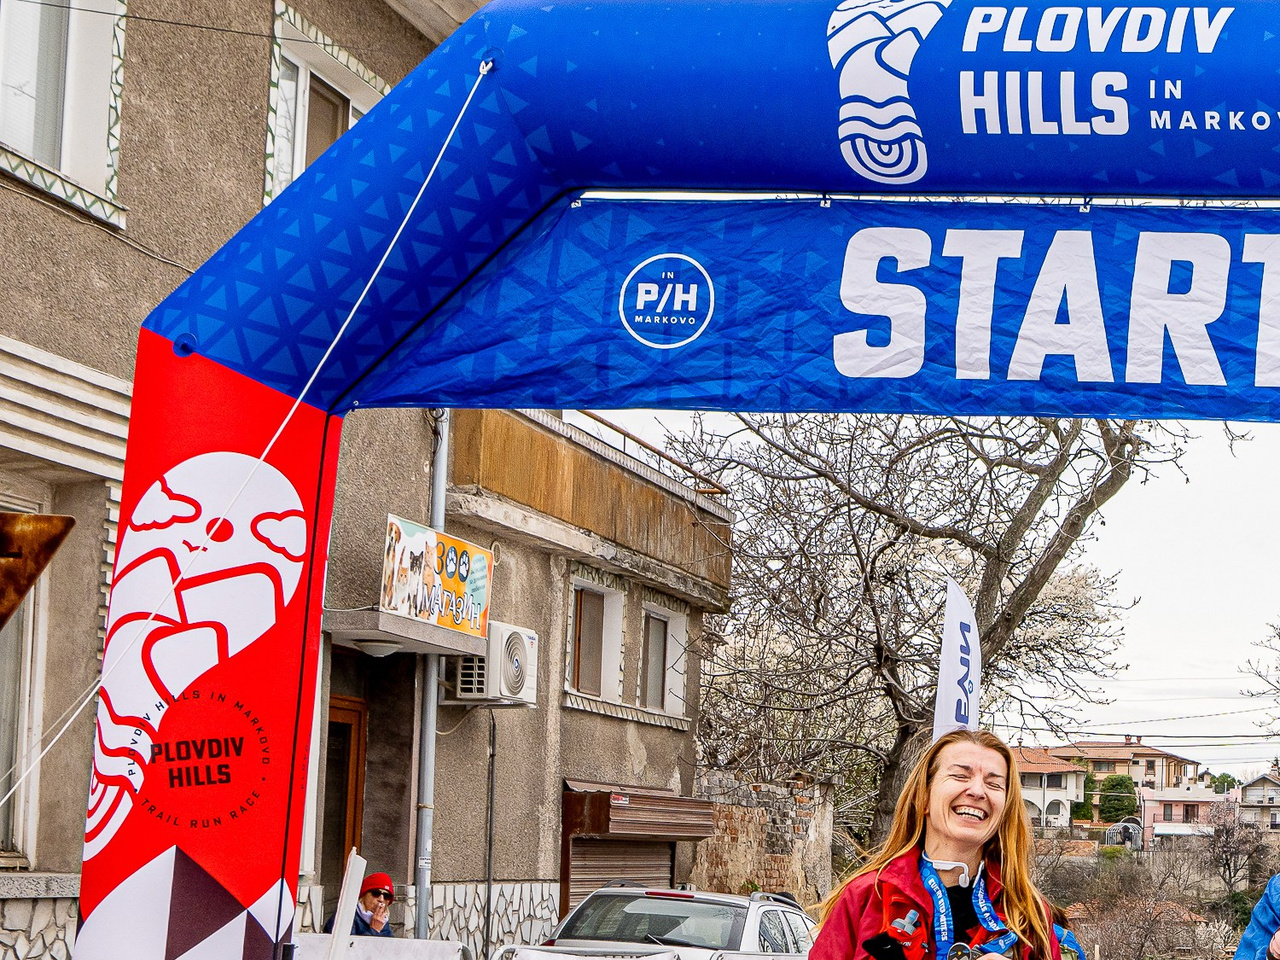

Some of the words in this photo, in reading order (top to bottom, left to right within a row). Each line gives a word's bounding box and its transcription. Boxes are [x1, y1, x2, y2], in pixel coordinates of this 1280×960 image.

[962, 6, 1236, 54] PLOVDIV
[959, 70, 1130, 136] HILLS
[1149, 79, 1182, 99] IN
[661, 271, 674, 279] IN
[636, 282, 698, 313] P/H
[634, 315, 696, 325] MARKOVO
[422, 583, 481, 631] МАГАЗИН
[210, 691, 227, 703] IN
[233, 701, 270, 765] MARKOVO
[150, 736, 244, 764] PLOVDIV
[168, 763, 231, 788] HILLS
[141, 798, 180, 827] TRAIL
[190, 817, 222, 828] RUN
[229, 790, 260, 819] RACE
